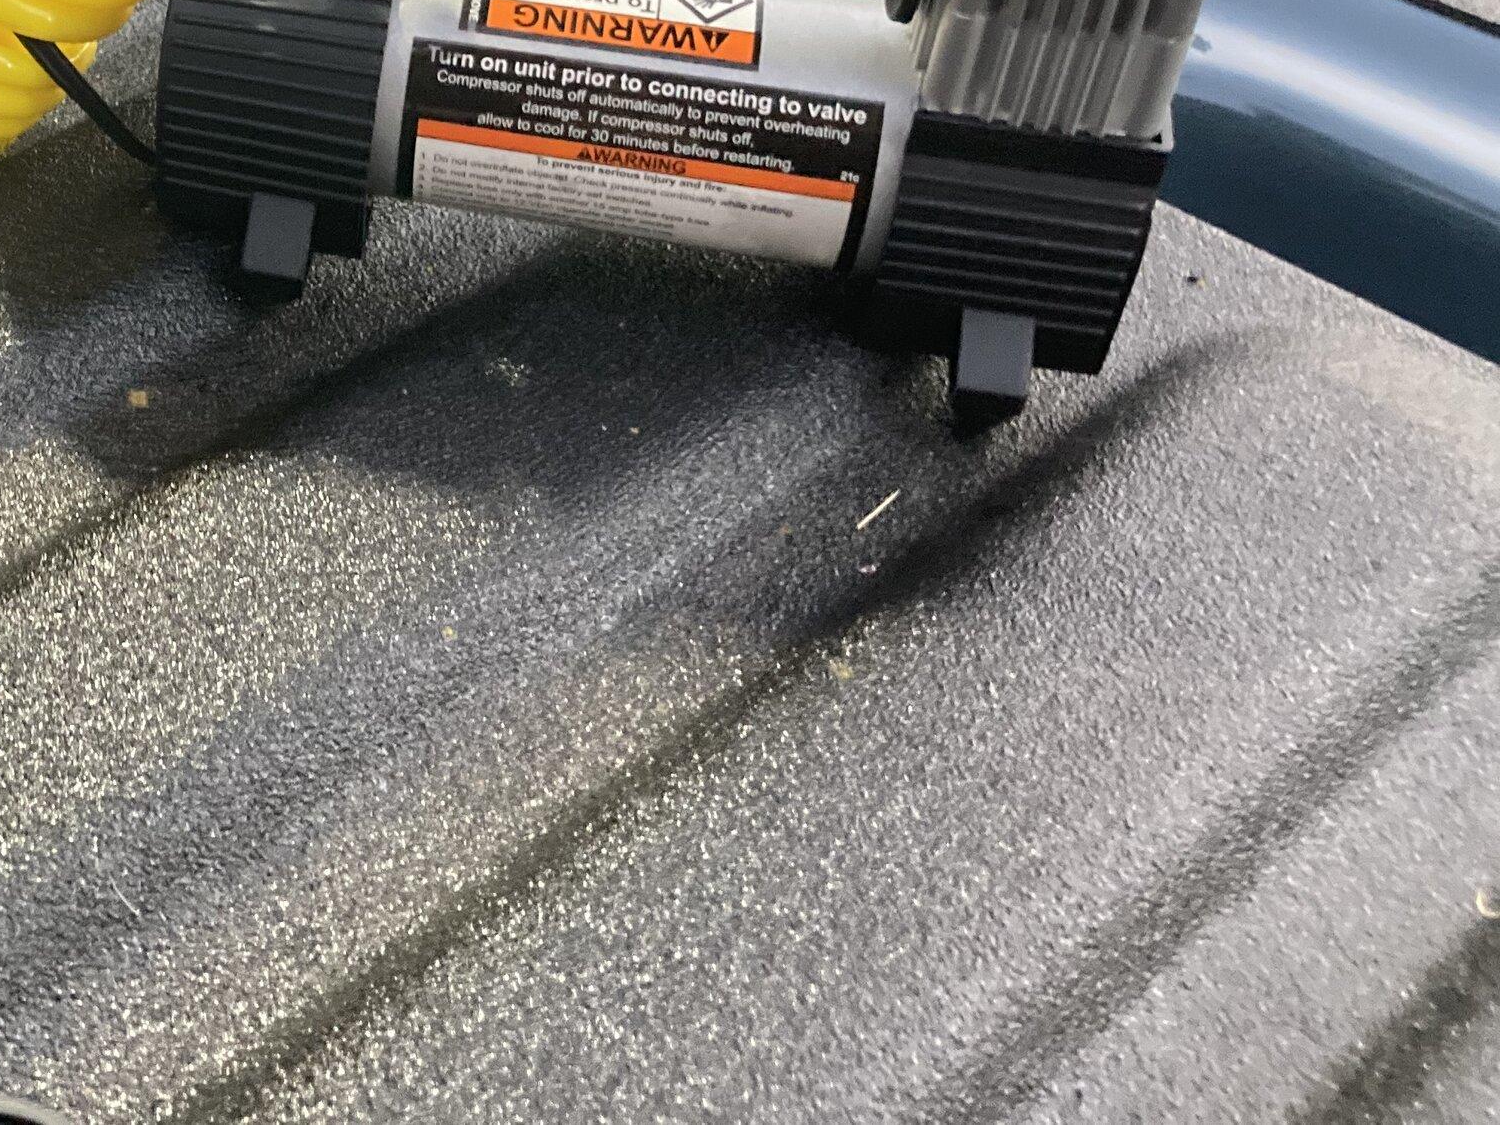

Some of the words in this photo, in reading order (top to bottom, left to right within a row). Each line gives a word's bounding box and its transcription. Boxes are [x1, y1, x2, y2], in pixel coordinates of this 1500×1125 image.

[513, 3, 697, 51] WARNING
[429, 45, 474, 69] Turn
[480, 55, 508, 74] on
[514, 59, 556, 81] unit
[562, 65, 615, 89] prior
[620, 73, 643, 93] to
[648, 78, 773, 115] connecting
[779, 94, 801, 116] to
[808, 101, 868, 125] valve
[437, 69, 523, 94] Compressor
[525, 82, 564, 101] shuts
[567, 87, 587, 103] off
[589, 91, 684, 119] automatically
[687, 105, 702, 120] to
[704, 109, 761, 129] prevent
[763, 118, 851, 145] overheating
[476, 112, 514, 129] allow
[517, 118, 531, 131] to
[534, 121, 564, 136] cool
[568, 125, 587, 140] for
[590, 128, 610, 143] 30
[612, 131, 669, 152] minutes
[673, 141, 720, 160] before
[521, 100, 582, 123] damage.
[588, 110, 599, 123] If
[600, 113, 686, 137] compressor
[688, 125, 728, 143] shuts
[552, 159, 597, 174] prevent
[598, 167, 640, 180] serious
[643, 171, 675, 187] injury
[678, 179, 701, 190] and
[591, 148, 687, 175] WARNING
